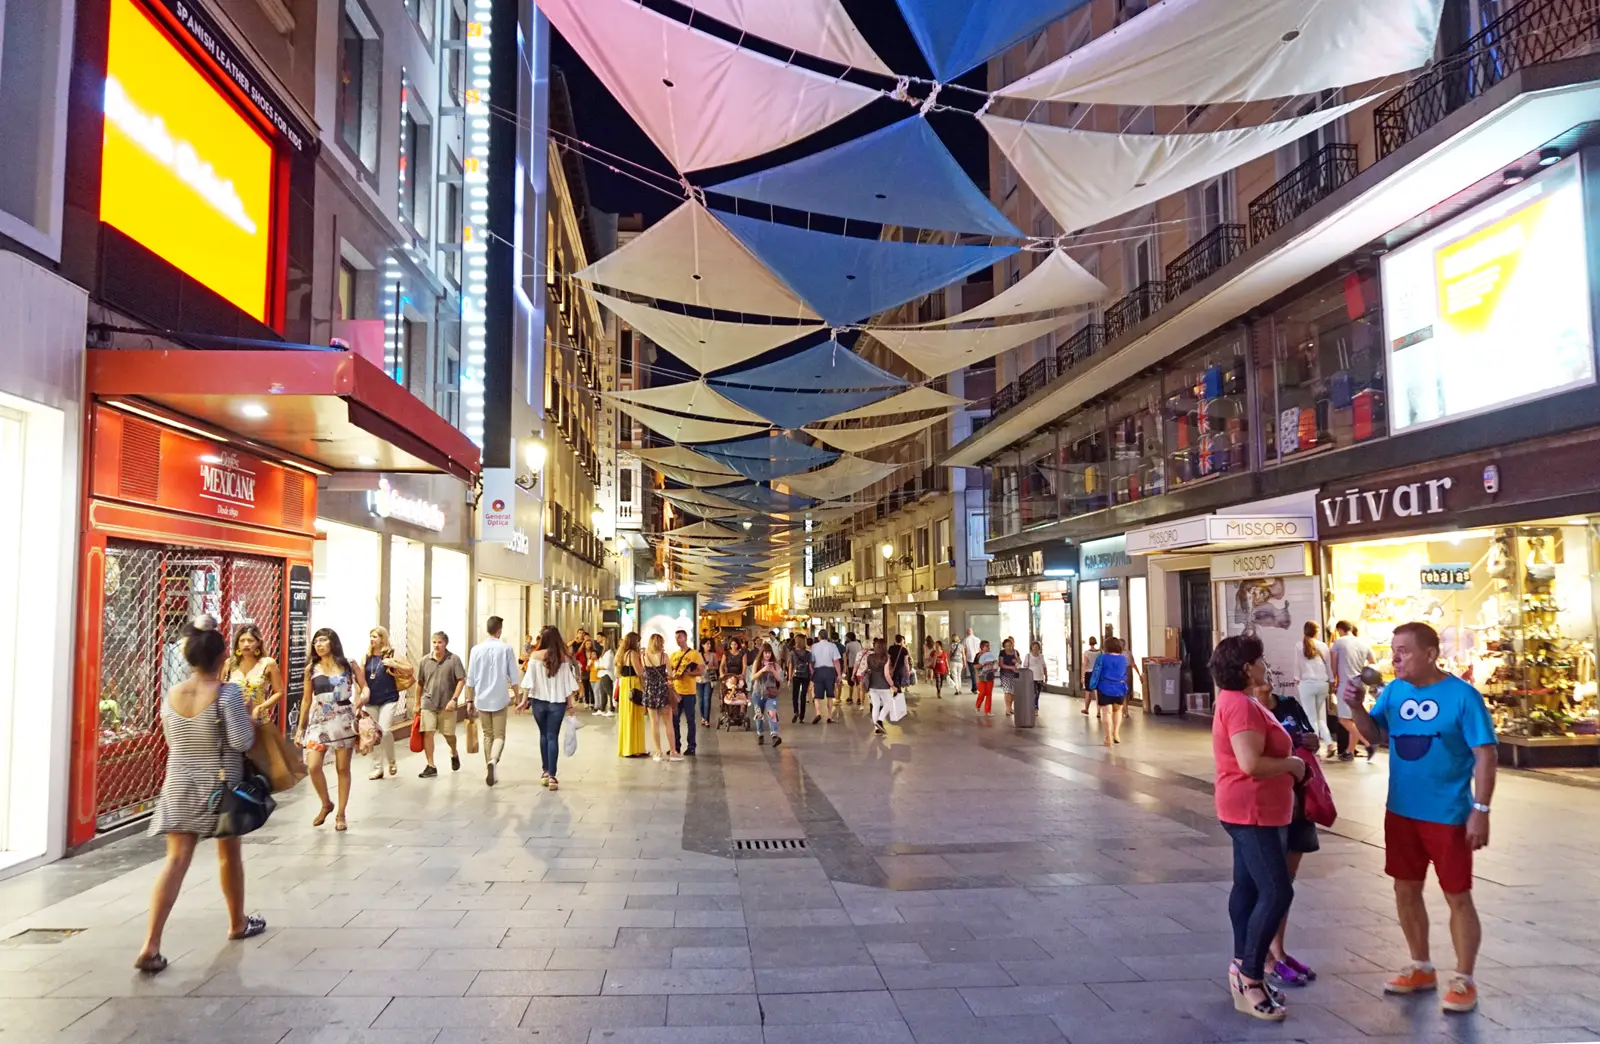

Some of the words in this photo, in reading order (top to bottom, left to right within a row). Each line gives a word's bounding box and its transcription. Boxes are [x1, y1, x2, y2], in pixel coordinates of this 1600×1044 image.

[176, 1, 215, 54] SPANISH
[216, 45, 249, 93] LEATHER
[251, 86, 274, 119] SHOES
[274, 111, 287, 134] FOR
[287, 127, 302, 151] KIDS
[203, 465, 255, 502] MEXICANA
[1148, 529, 1178, 546] MISSORO
[1226, 521, 1297, 537] MISSORO
[1233, 554, 1276, 573] MISSORO
[1421, 570, 1470, 583] rebajas
